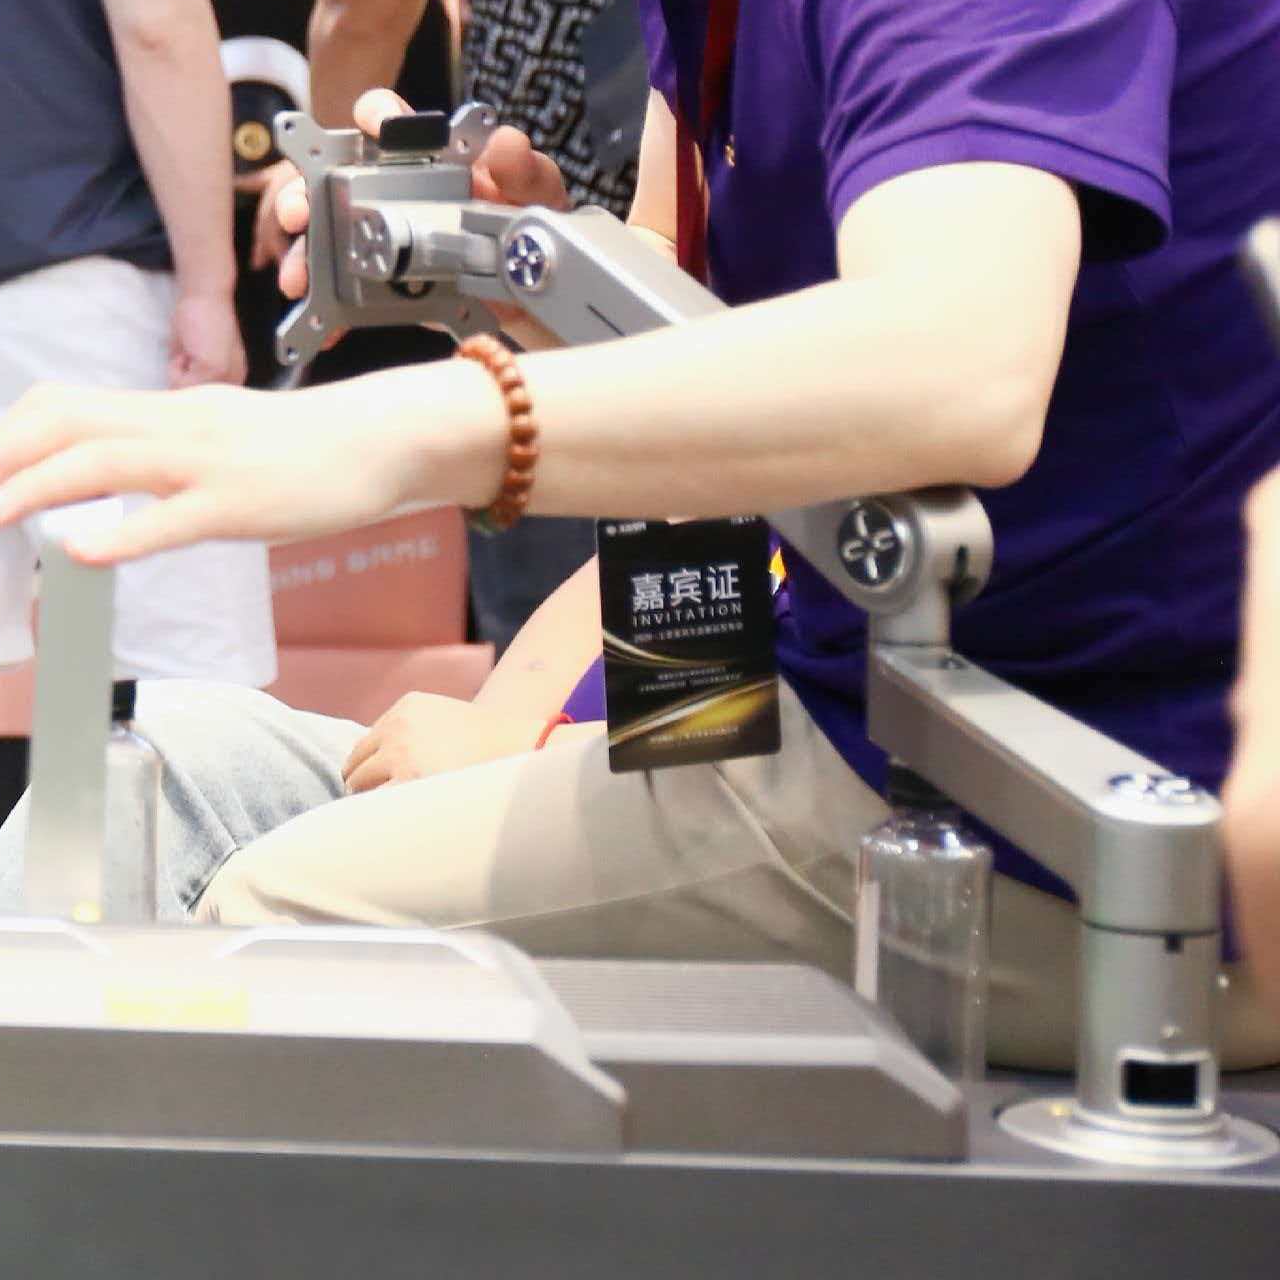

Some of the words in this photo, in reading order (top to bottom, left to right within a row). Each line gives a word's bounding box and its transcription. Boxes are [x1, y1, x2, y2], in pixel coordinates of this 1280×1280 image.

[630, 563, 742, 612] 嘉宾证
[632, 602, 743, 627] INVITATION
